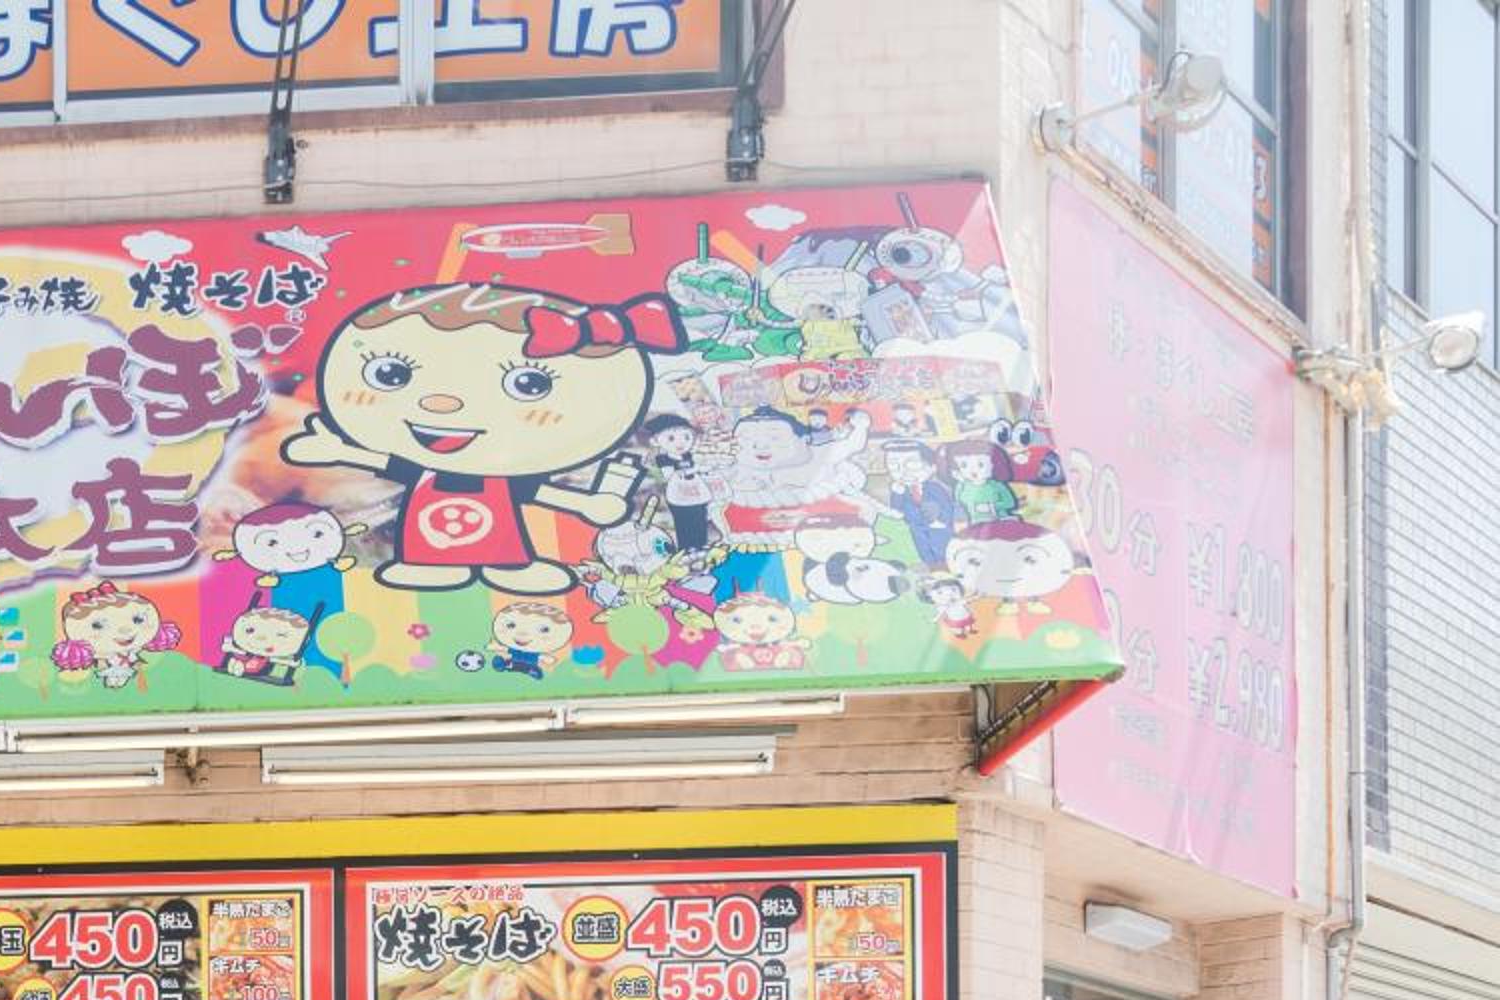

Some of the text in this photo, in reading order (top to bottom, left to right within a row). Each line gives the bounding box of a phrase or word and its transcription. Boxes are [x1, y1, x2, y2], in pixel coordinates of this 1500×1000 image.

[128, 262, 328, 314] 焼そば
[30, 911, 192, 968] 450 税込 円
[250, 928, 279, 948] 50
[375, 904, 556, 970] 焼そば
[572, 914, 621, 944] 並盛
[627, 896, 797, 955] 450 税込 円
[858, 933, 886, 950] 50
[819, 967, 880, 983] キムチ
